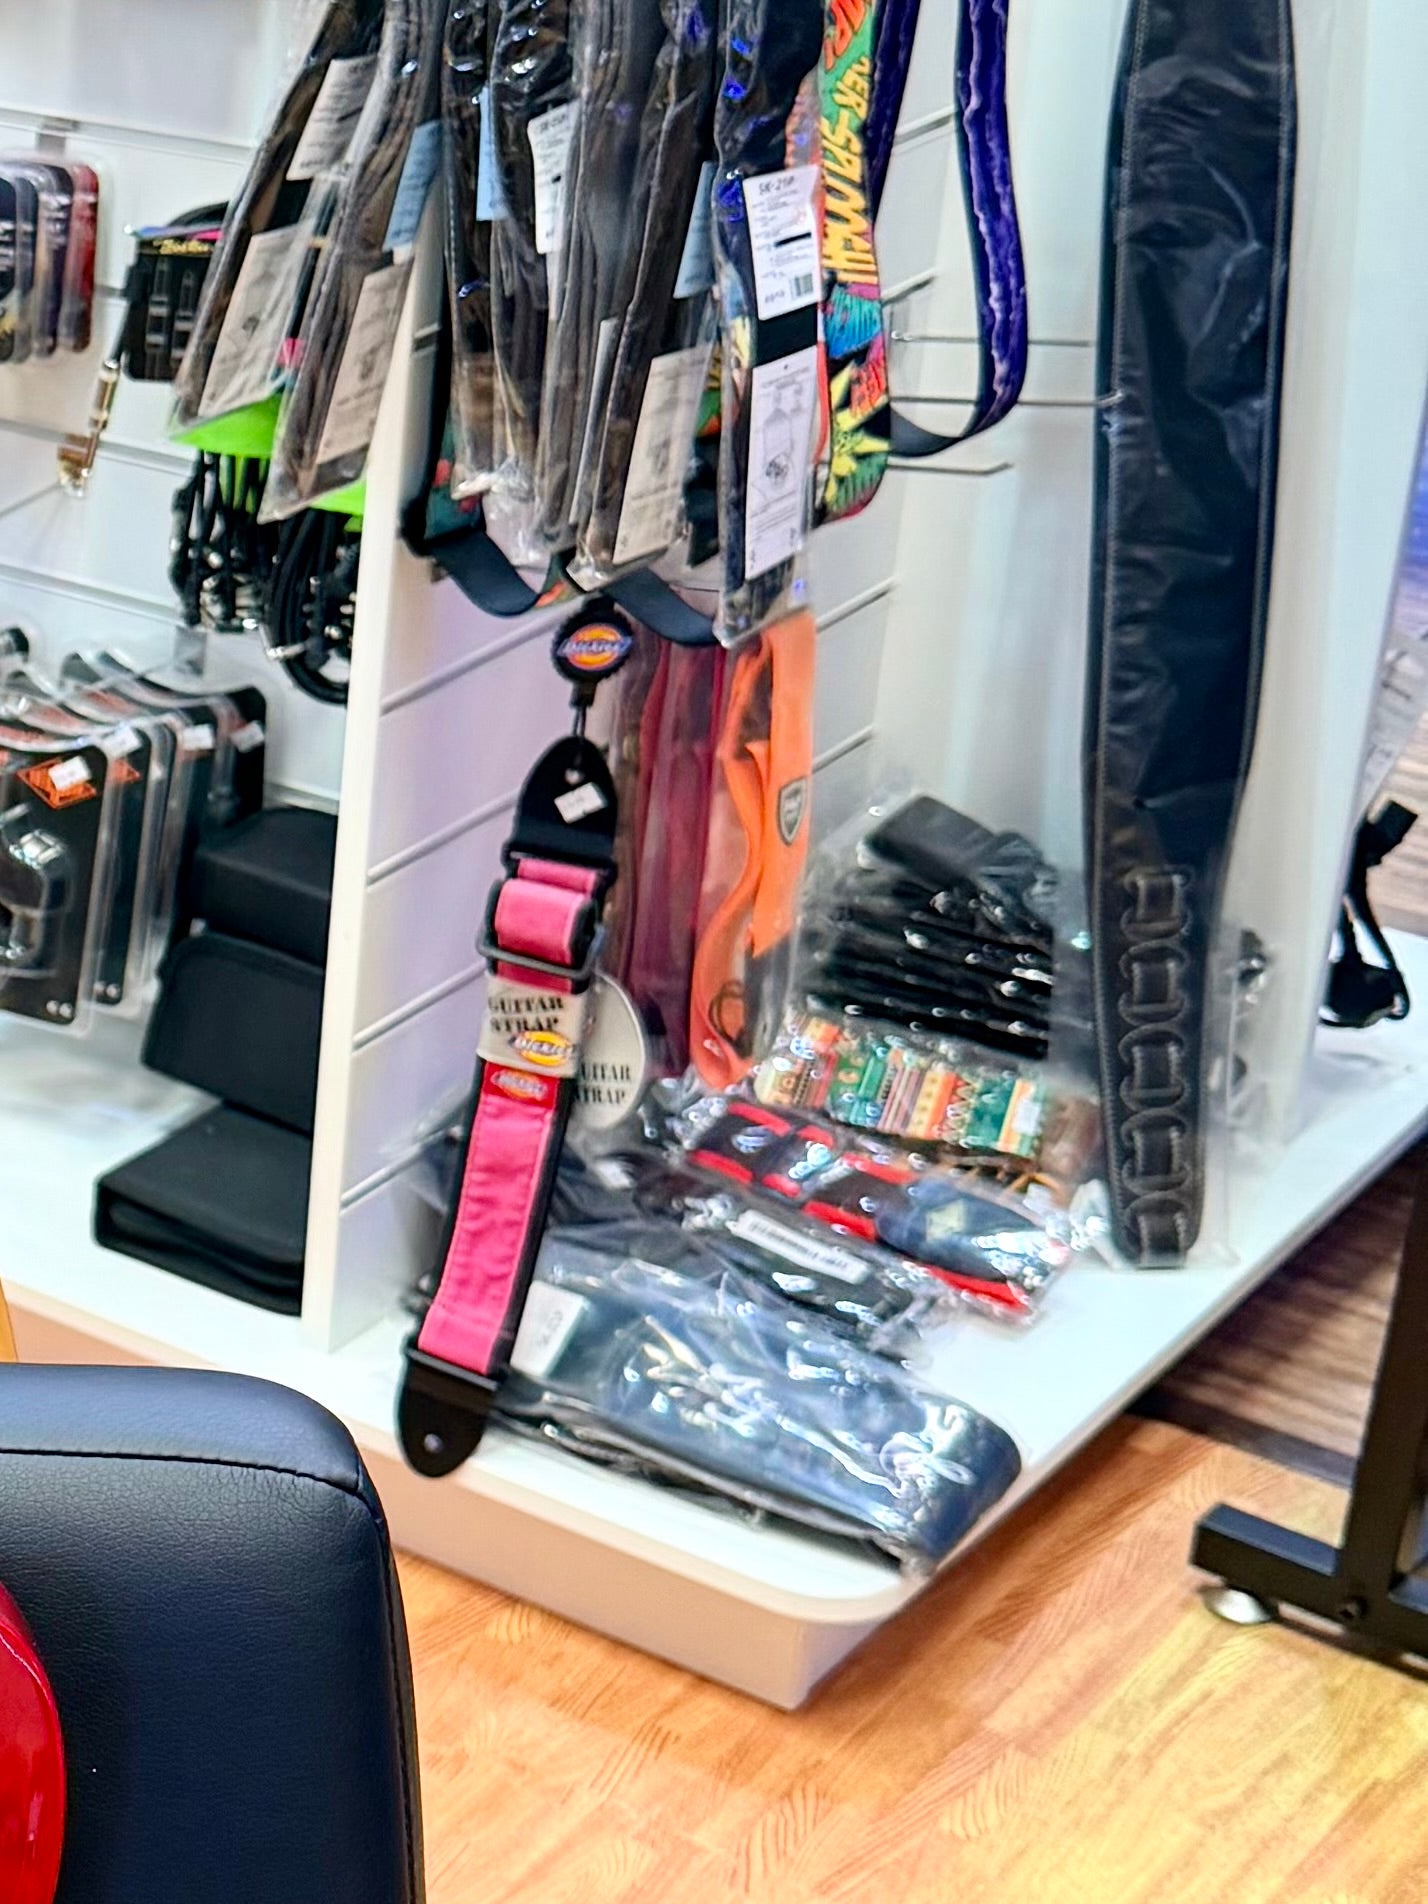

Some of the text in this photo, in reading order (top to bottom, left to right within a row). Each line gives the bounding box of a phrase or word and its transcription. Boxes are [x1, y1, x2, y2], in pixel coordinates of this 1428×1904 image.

[556, 633, 632, 658] Dickies
[488, 996, 565, 1016] GUITAR
[490, 1016, 559, 1034] STRAP
[578, 1061, 632, 1082] UITAR
